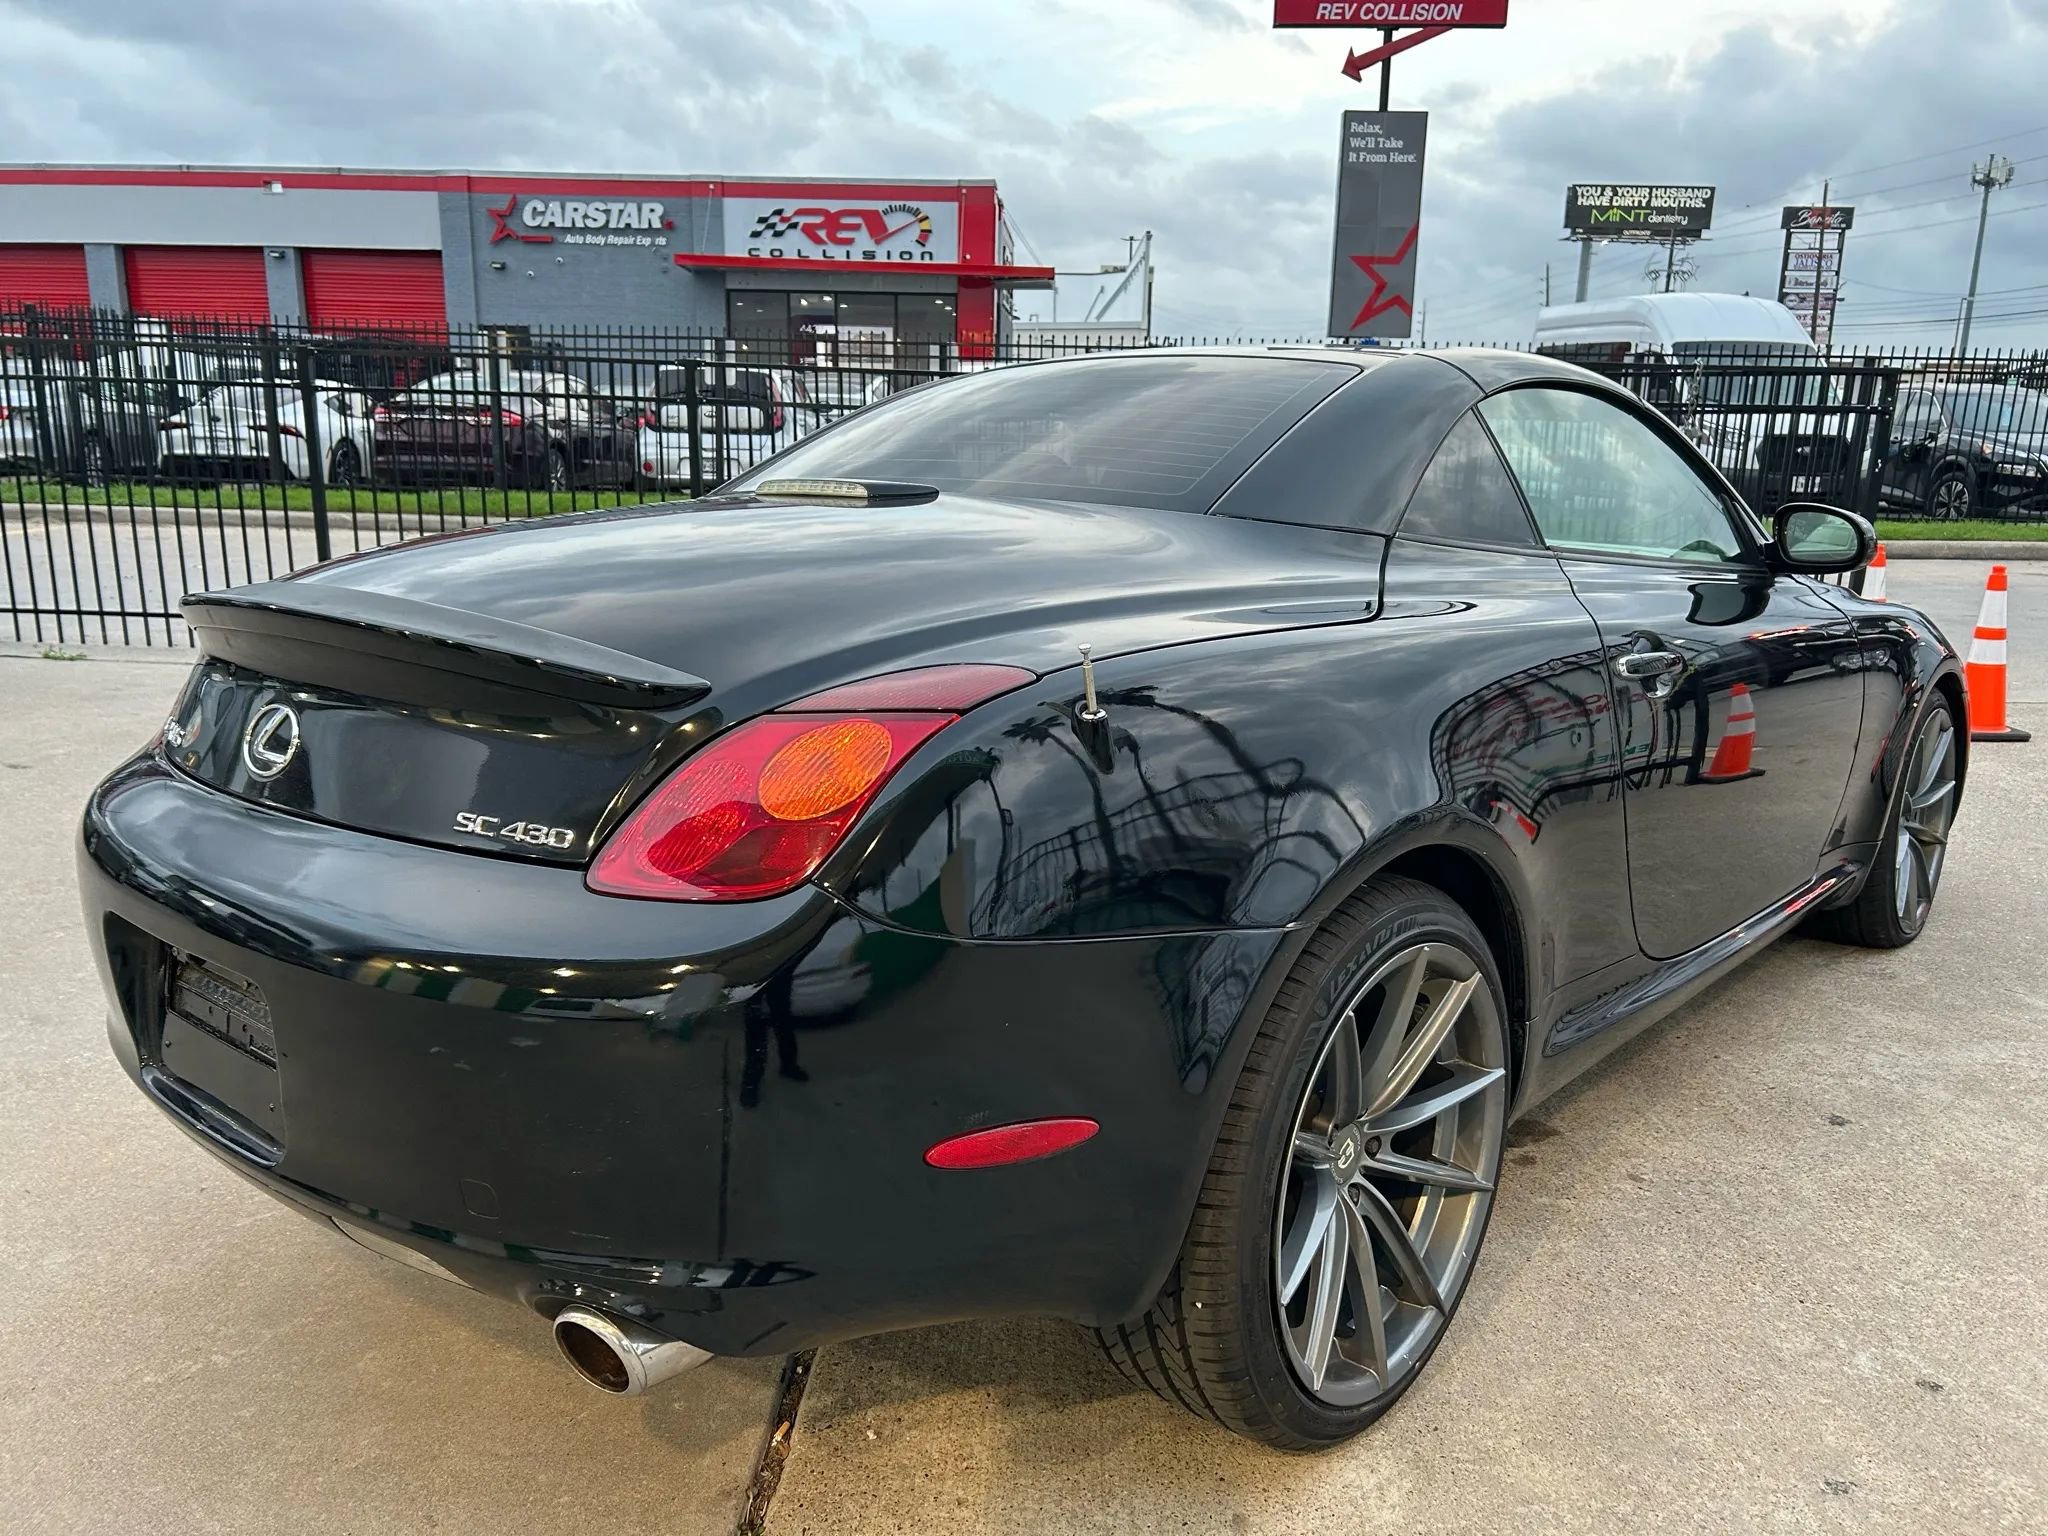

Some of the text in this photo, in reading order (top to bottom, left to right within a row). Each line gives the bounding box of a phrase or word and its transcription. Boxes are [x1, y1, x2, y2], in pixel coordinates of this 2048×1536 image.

[1316, 3, 1464, 20] REV COLLISION
[1350, 122, 1383, 134] Relax,
[1349, 137, 1404, 148] We'll Take
[1348, 152, 1357, 162] It
[1358, 152, 1387, 163] From
[1575, 186, 1711, 198] YOU & YOUR HUSBAND
[1577, 196, 1706, 208] HAVE DIRTY MOUTHS.
[522, 199, 664, 229] CARSTAR
[1648, 210, 1688, 226] dentistry
[792, 207, 915, 246] REV
[564, 233, 585, 244] Auto
[586, 234, 606, 246] Body
[607, 234, 635, 246] Repair
[453, 811, 576, 849] SC 430
